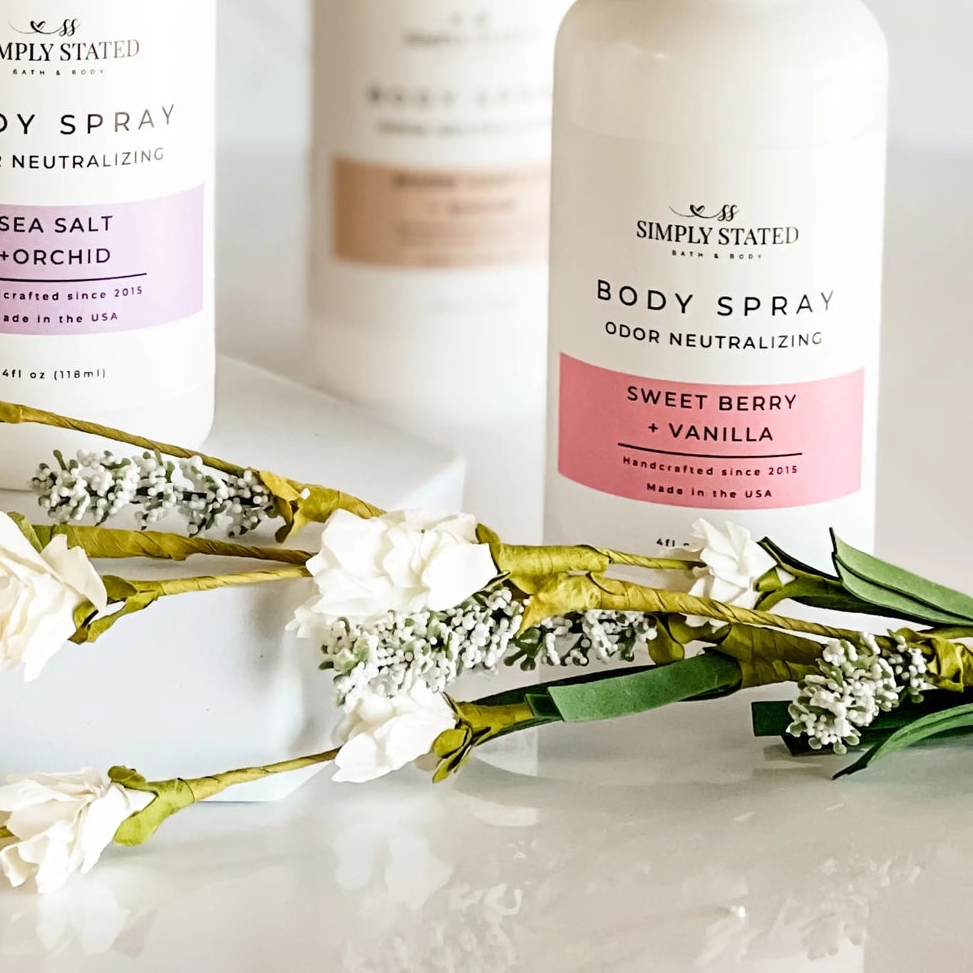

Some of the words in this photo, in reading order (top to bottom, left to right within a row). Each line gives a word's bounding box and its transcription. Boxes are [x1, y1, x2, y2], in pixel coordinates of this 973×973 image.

[60, 38, 139, 61] STATED
[60, 105, 174, 135] SPRAY
[12, 148, 163, 169] NEUTRALIZING
[55, 216, 113, 233] SALT
[636, 220, 713, 245] SIMPLY
[718, 227, 798, 245] STATED
[0, 248, 110, 265] +ORCHID
[68, 291, 106, 300] since
[114, 286, 142, 297] 2015
[598, 279, 693, 314] BODY
[717, 290, 834, 317] SPRAY
[37, 315, 50, 323] in
[59, 315, 82, 323] the
[91, 312, 117, 322] USA
[605, 321, 659, 344] ODOR
[670, 332, 821, 349] NEUTRALIZING
[2, 369, 21, 378] 4fl
[54, 369, 105, 381] (118ml)
[627, 386, 708, 410] SWEET
[719, 394, 796, 411] BERRY
[648, 423, 658, 433] +
[669, 423, 773, 442] VANILLA
[623, 456, 714, 476] Handcrafted
[722, 468, 760, 476] since
[768, 465, 797, 475] 2015
[647, 483, 683, 495] Made
[691, 487, 704, 497] in
[713, 490, 736, 498] the
[745, 490, 772, 498] USA
[656, 538, 675, 547] 4fl
